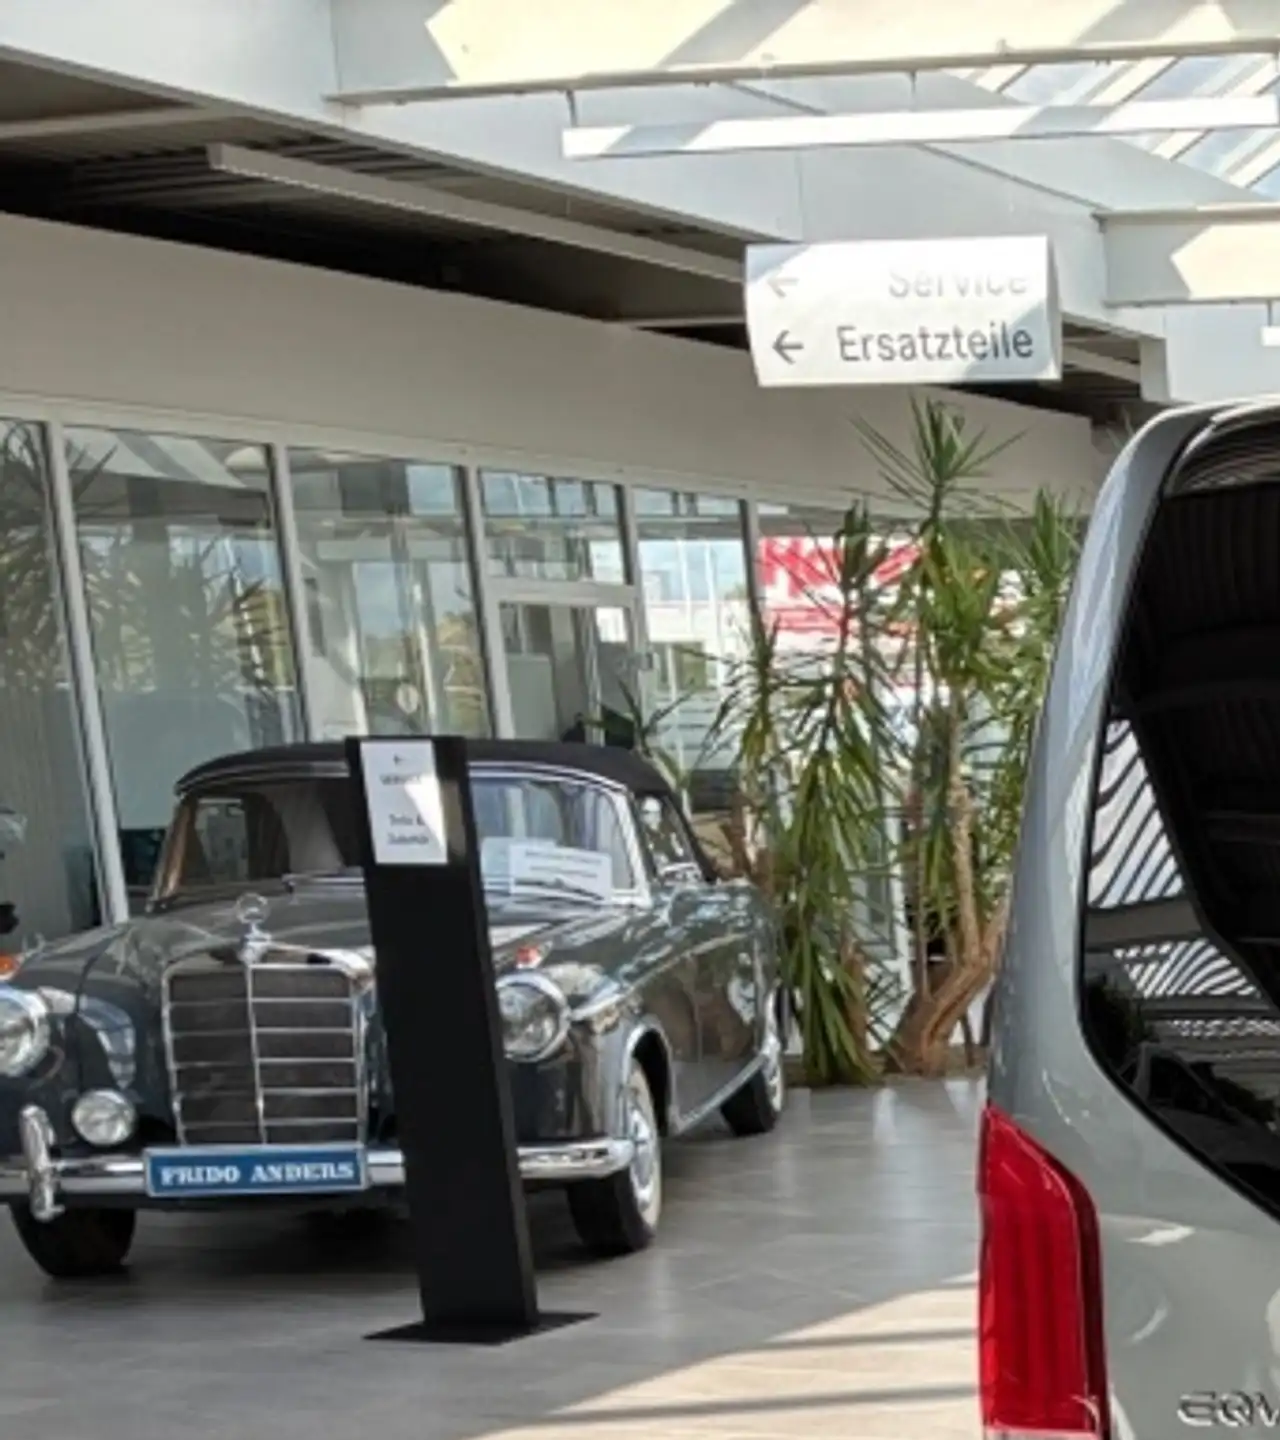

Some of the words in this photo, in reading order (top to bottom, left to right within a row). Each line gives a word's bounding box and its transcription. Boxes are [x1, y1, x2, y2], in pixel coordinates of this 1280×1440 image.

[836, 320, 1034, 361] Ersatzteile
[160, 1165, 241, 1187] FRIDO
[250, 1161, 354, 1183] ANDERS
